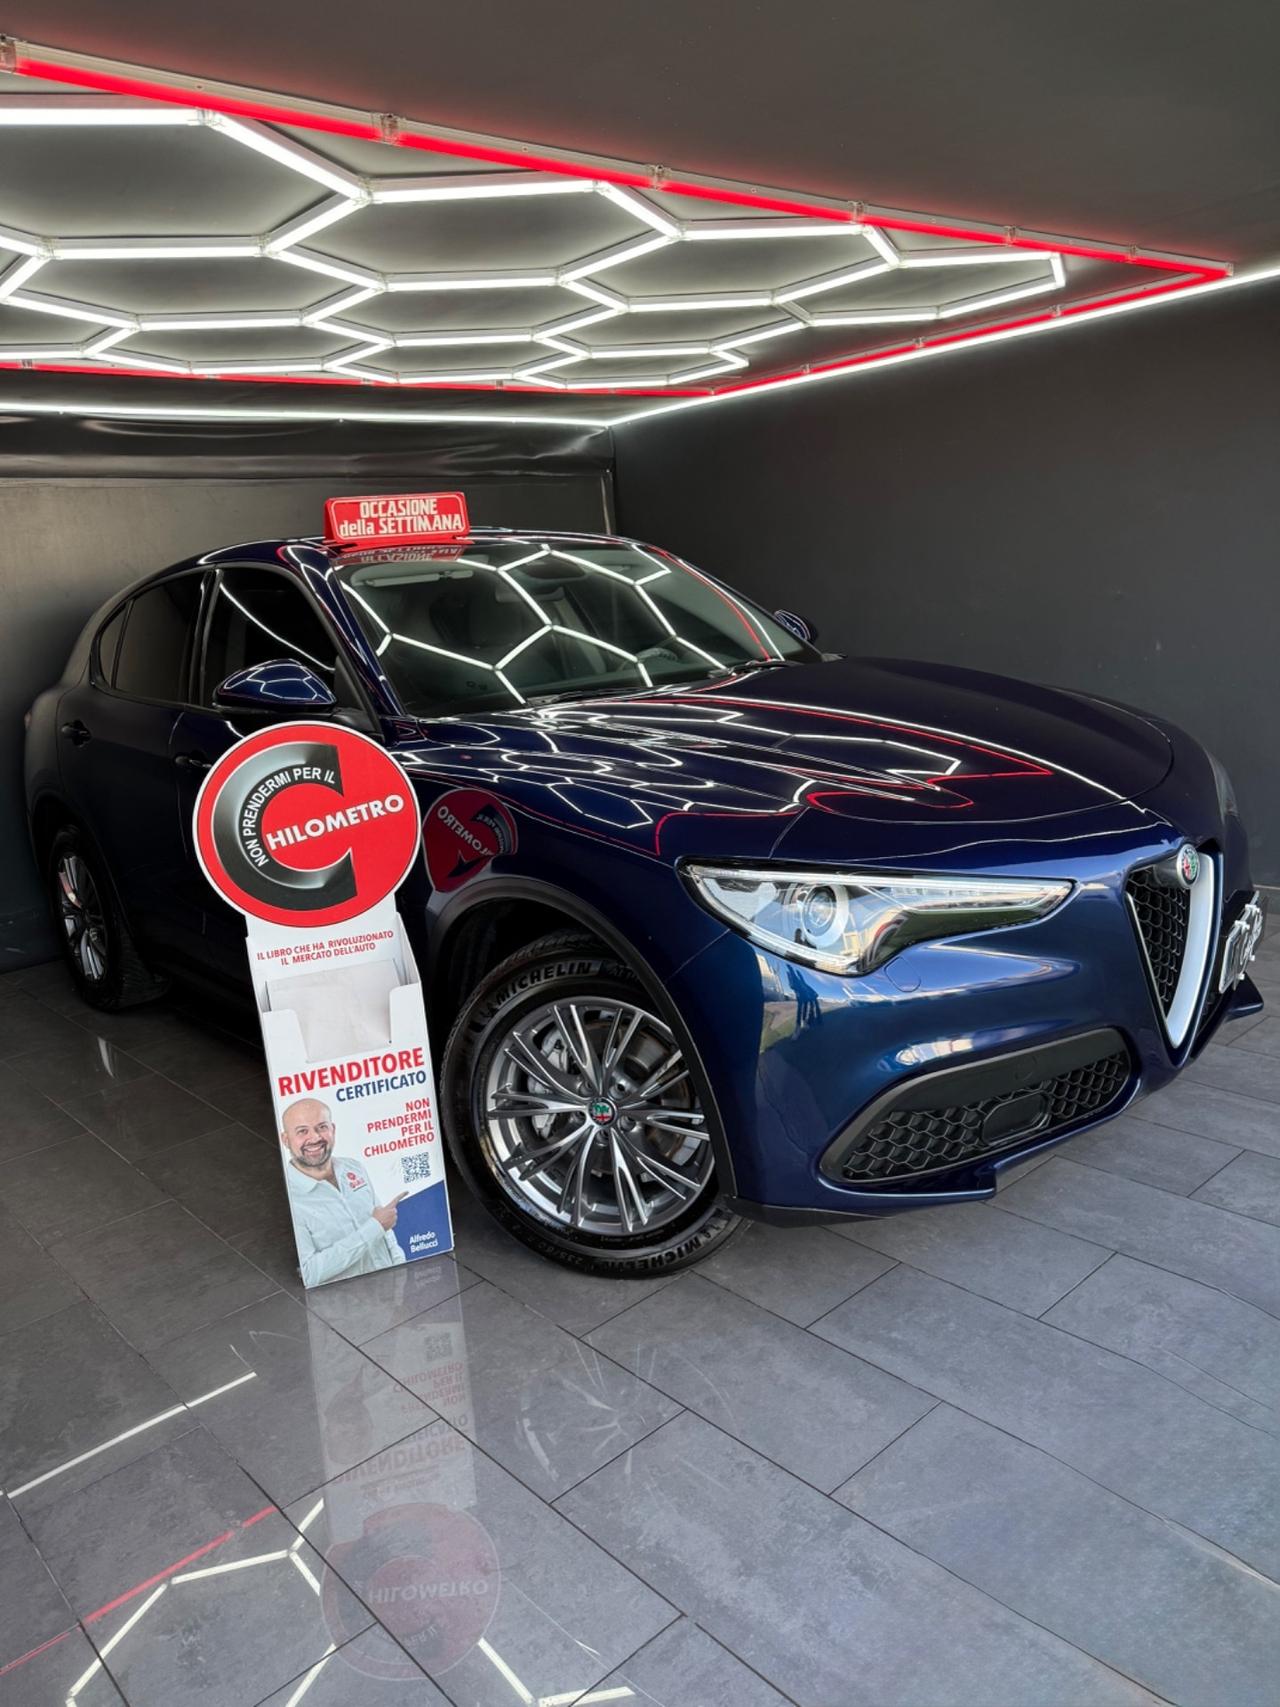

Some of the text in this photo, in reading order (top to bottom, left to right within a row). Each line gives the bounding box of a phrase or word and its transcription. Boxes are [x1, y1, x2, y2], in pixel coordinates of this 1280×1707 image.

[359, 498, 438, 518] OCCASIONE
[339, 514, 463, 537] della SETTIMANA
[242, 767, 335, 867] NON PRENDERMI PER IL
[266, 794, 404, 851] HILOMETRO
[267, 947, 292, 959] LIBRO
[294, 943, 311, 954] CHE
[312, 942, 325, 951] HA
[328, 930, 394, 948] RIVOLUZIONATO
[281, 942, 376, 966] IL MERCATO DELL'AUTO
[495, 961, 593, 1002] MICHELIN
[278, 1047, 425, 1097] RIVENDITORE
[336, 1070, 427, 1102] CERTIFICATO
[405, 1097, 430, 1112] NON
[367, 1109, 432, 1133] PRENDERMI
[401, 1120, 434, 1136] PER IL
[364, 1132, 435, 1157] CHILOMETRO
